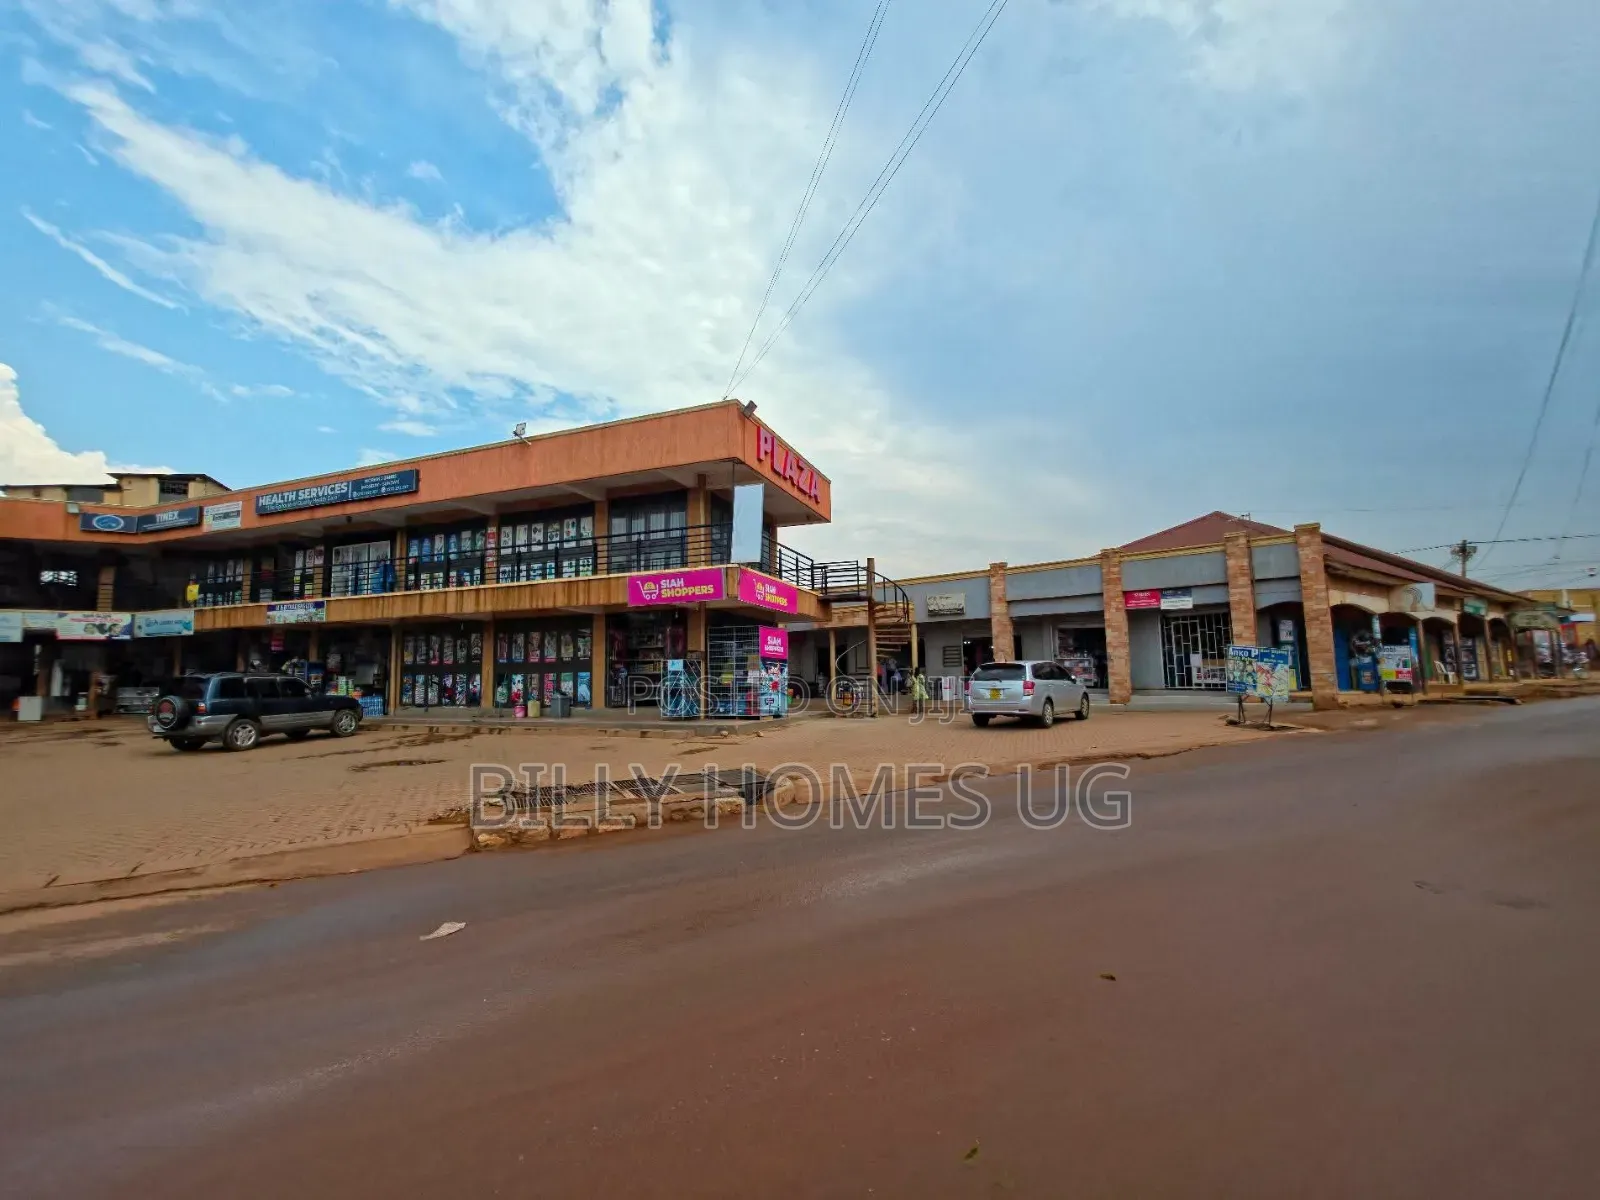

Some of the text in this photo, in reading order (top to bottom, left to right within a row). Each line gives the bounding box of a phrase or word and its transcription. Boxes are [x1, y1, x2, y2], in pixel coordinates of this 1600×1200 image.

[757, 426, 820, 503] PLAZA
[258, 490, 297, 507] HEALTH
[298, 482, 348, 500] SERVICES
[660, 578, 684, 588] SIAH
[764, 583, 776, 593] SIAH
[661, 585, 714, 598] SHOPPERS
